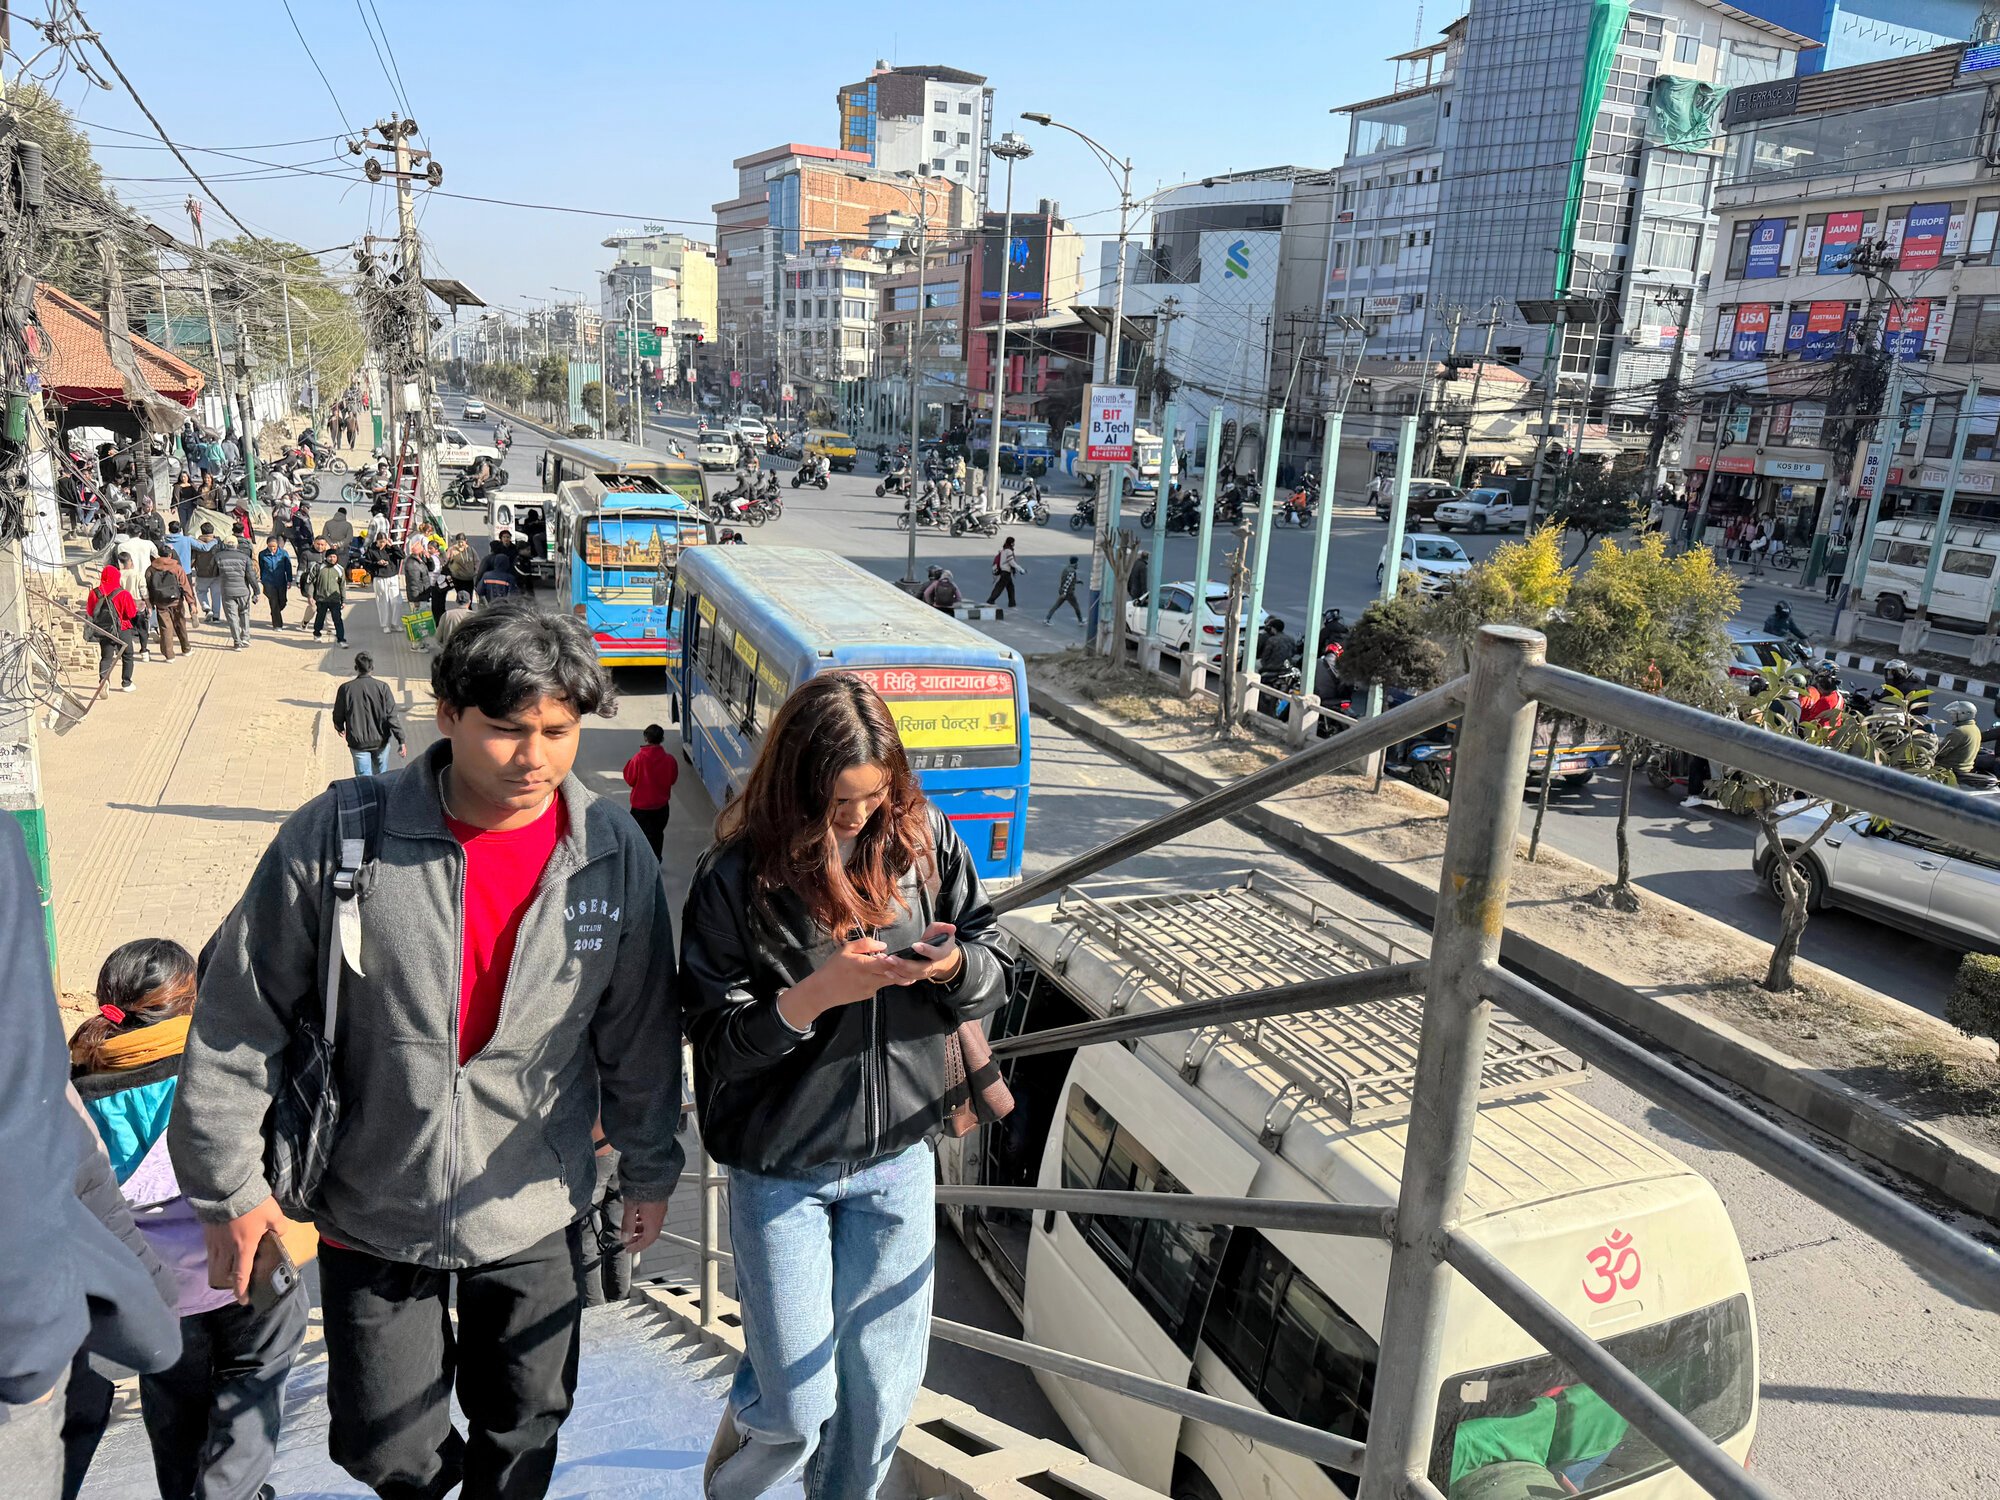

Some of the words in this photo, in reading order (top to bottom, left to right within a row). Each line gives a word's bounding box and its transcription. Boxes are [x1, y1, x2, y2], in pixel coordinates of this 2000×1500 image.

[643, 221, 664, 232] bridge
[1911, 217, 1945, 227] EUROPE
[1828, 224, 1858, 234] JAPAN
[1905, 249, 1937, 257] DENMARK
[1740, 312, 1764, 323] USA
[1738, 340, 1757, 351] UK
[1092, 395, 1117, 404] ORCHID
[1103, 409, 1122, 420] BIT
[1093, 421, 1130, 433] B.Tech
[1622, 420, 1633, 433] D
[1104, 434, 1117, 444] AI
[1776, 461, 1792, 470] KOS
[1794, 464, 1804, 472] BY
[920, 674, 987, 691] यातायात
[563, 898, 620, 922] USERA
[578, 924, 602, 932] RIYADH
[573, 937, 603, 951] 2005
